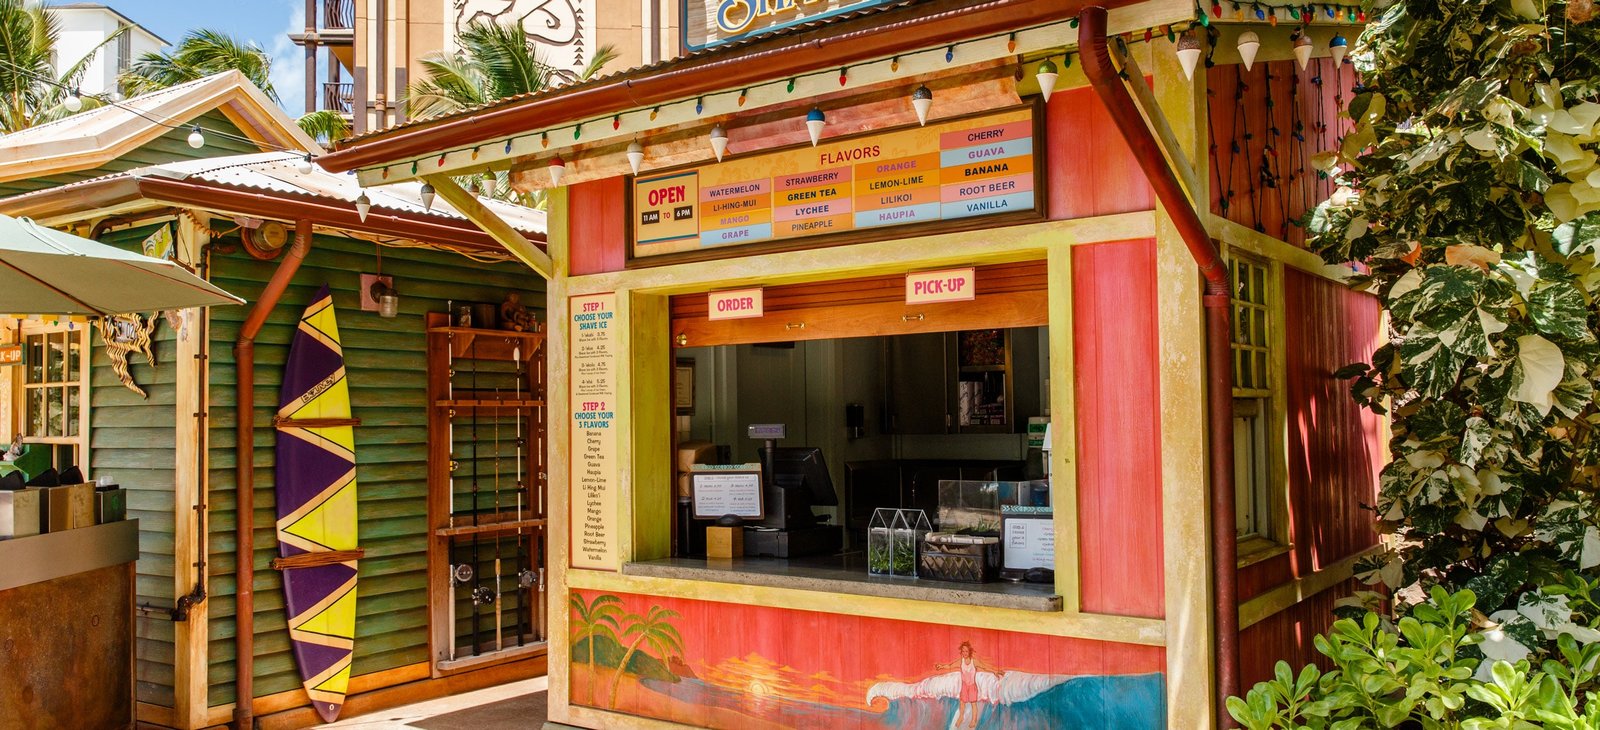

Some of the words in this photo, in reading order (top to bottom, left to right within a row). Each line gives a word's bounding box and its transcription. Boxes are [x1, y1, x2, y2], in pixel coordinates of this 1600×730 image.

[968, 129, 1004, 142] CHERRY
[820, 145, 880, 165] FLAVORS
[968, 147, 1005, 159] GUAVA
[877, 160, 916, 173] ORANGE
[965, 164, 1008, 177] BANANA
[786, 172, 839, 187] STRAWBERRY
[870, 176, 924, 190] LEMON-LIME
[710, 184, 760, 197] WATERMELON
[788, 191, 816, 201] GREEN
[819, 188, 836, 198] TEA
[960, 185, 986, 196] ROOT
[989, 181, 1015, 192] BEER
[648, 185, 685, 206] OPEN
[881, 194, 912, 204] LILIKOI
[714, 200, 756, 211] LI-HING-MUI
[795, 205, 829, 216] LYCHEE
[967, 200, 1008, 212] VANILLA
[720, 215, 749, 225] MANGO
[879, 210, 915, 221] HAUPIA
[792, 220, 832, 231] PINEAPPLE
[722, 230, 749, 240] GRAPE
[914, 278, 965, 295] PICK-UP
[583, 303, 599, 312] STEP
[717, 297, 753, 311] ORDER
[574, 313, 595, 321] CHOOSE
[580, 322, 597, 330] SHAVE
[583, 402, 598, 411] STEP
[601, 402, 605, 410] 2
[584, 539, 606, 547] Strawberry
